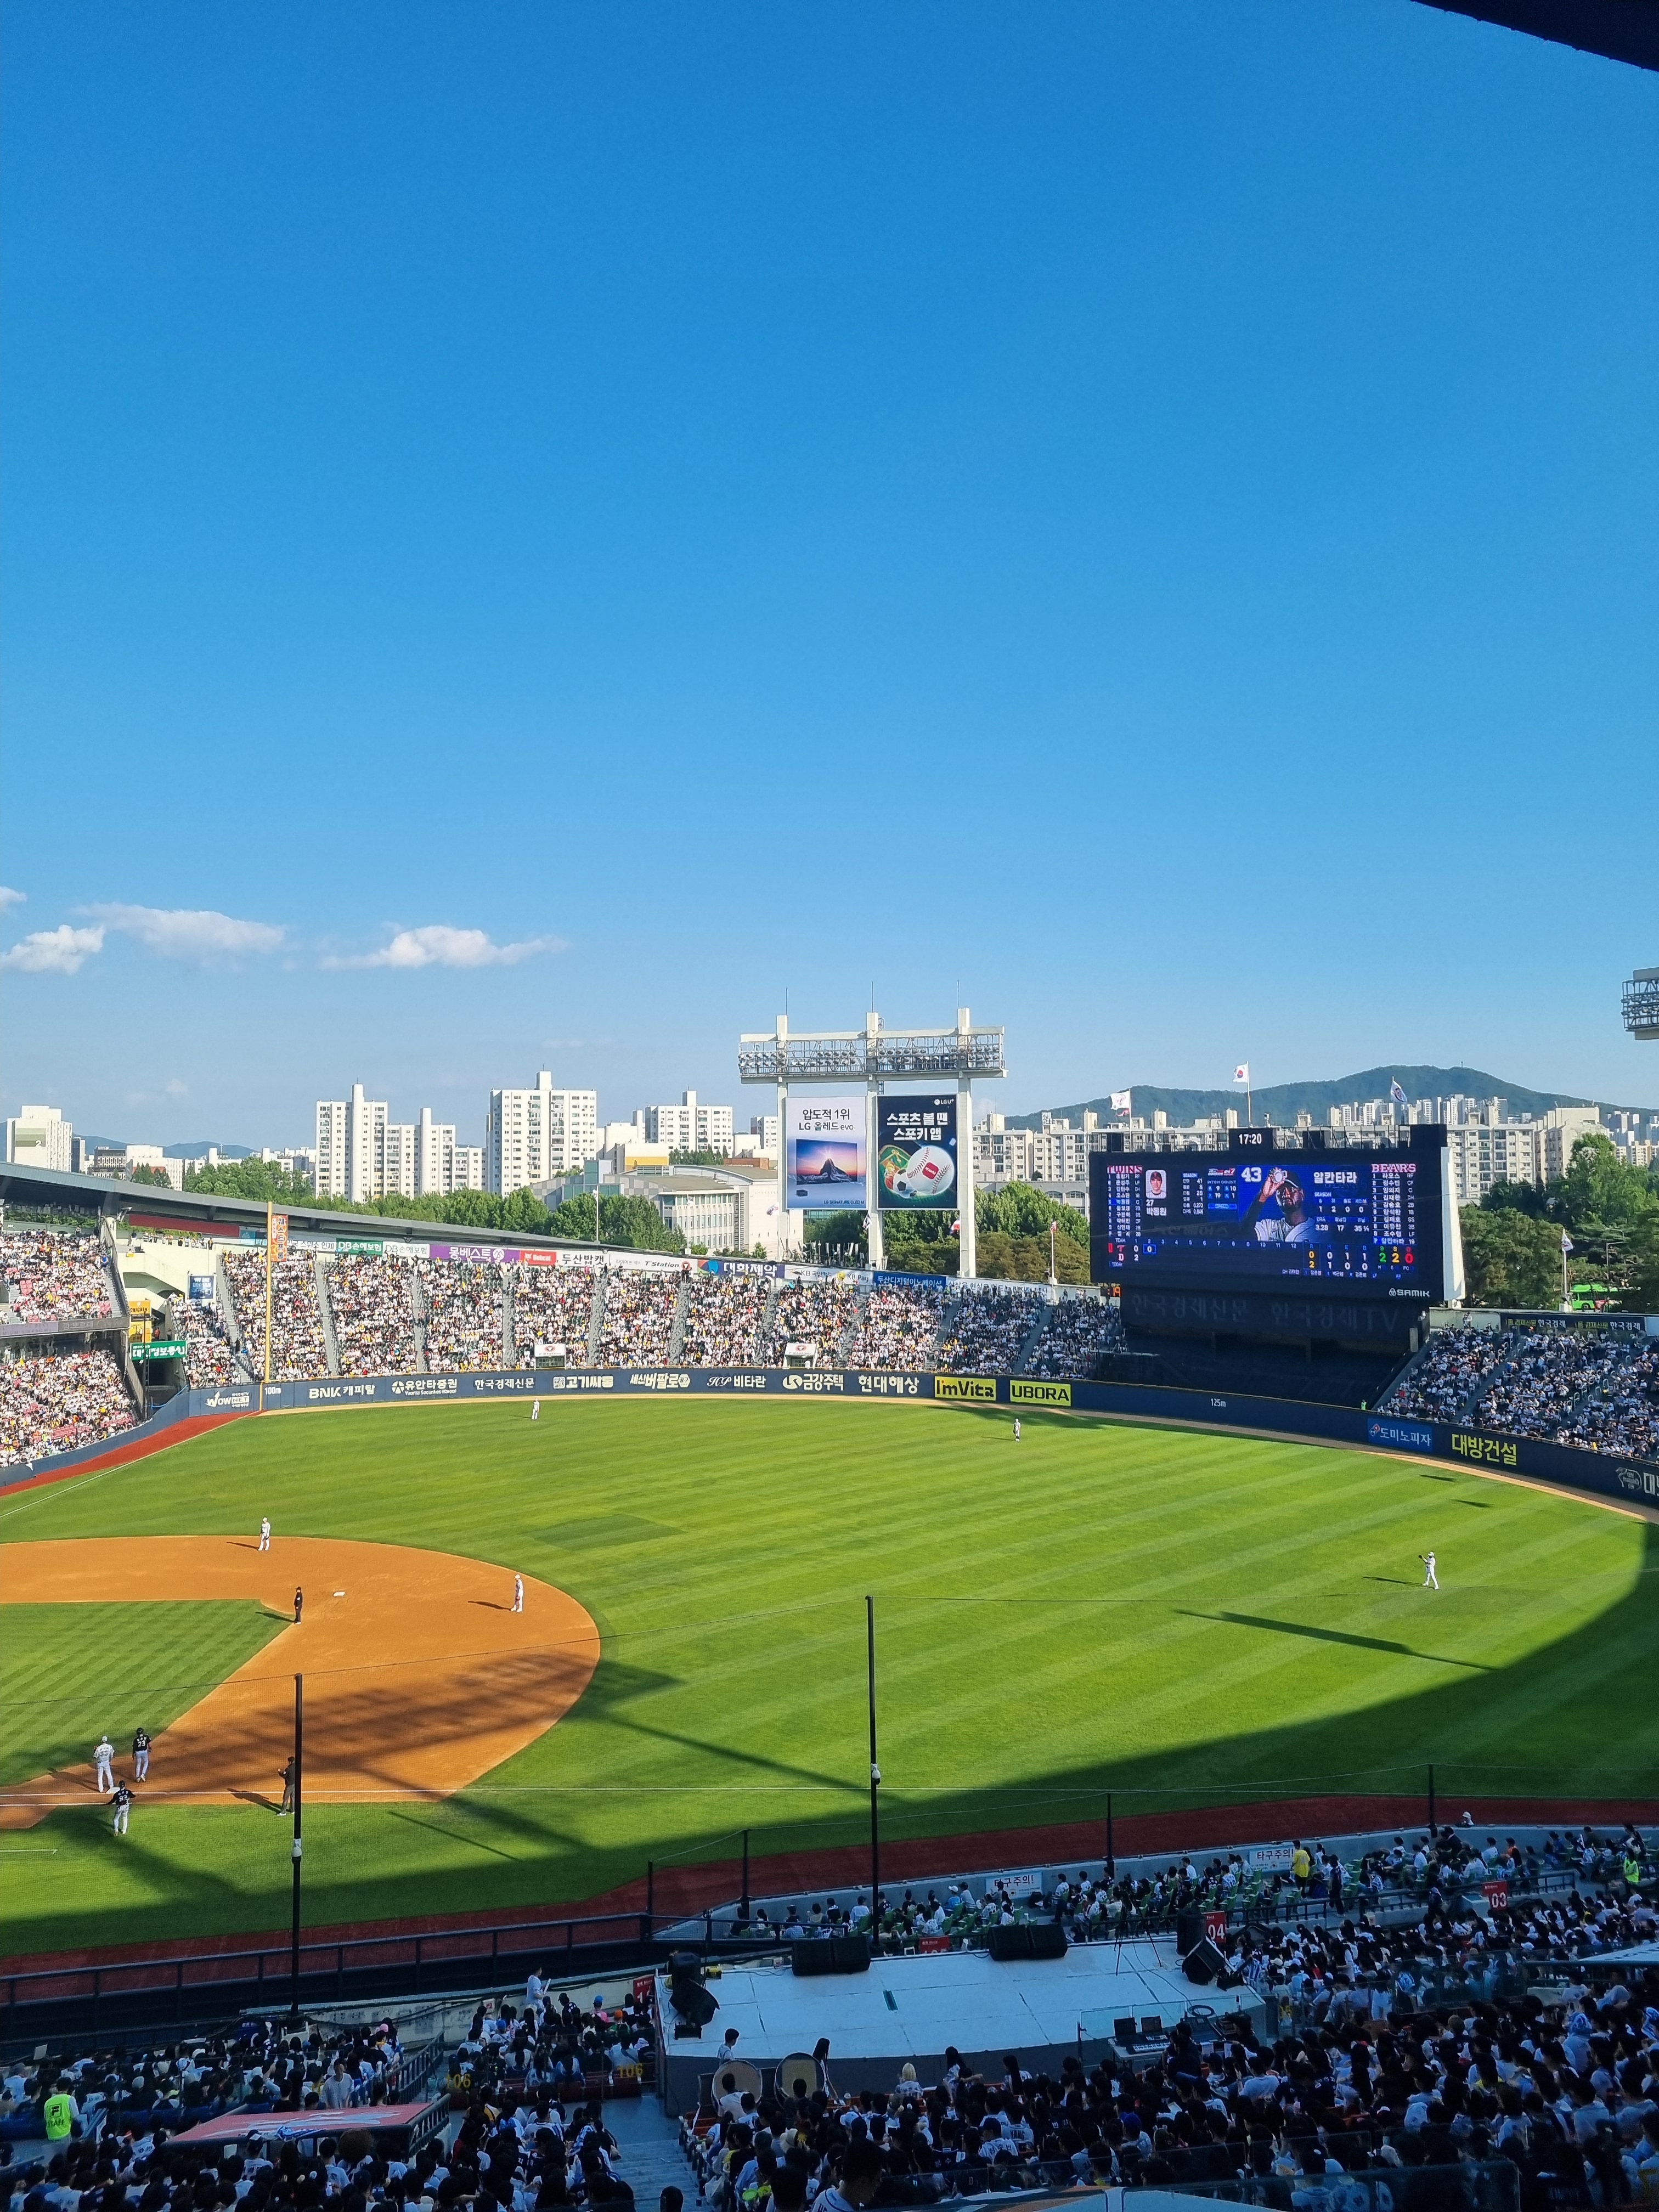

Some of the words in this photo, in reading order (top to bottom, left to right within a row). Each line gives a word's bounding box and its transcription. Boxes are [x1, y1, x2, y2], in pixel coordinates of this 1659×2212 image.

[803, 1108, 832, 1120] 압도적
[834, 1108, 850, 1120] 1위
[887, 1113, 921, 1126] 스포츠
[923, 1113, 935, 1126] 볼
[937, 1113, 948, 1126] 땐
[799, 1122, 811, 1131] LG
[814, 1121, 839, 1131] 올레드
[894, 1127, 928, 1141] 스포키
[930, 1127, 941, 1141] 앱
[1239, 1133, 1262, 1144] 17:20
[1372, 1164, 1416, 1172] BEARS
[1241, 1167, 1261, 1182] 43
[1313, 1172, 1357, 1183] 알칸타라
[1147, 1207, 1166, 1216] 박동원
[338, 1242, 352, 1250] DB
[352, 1243, 381, 1252] 손해보험
[385, 1244, 398, 1254] DB
[399, 1245, 427, 1254] 손해보험
[449, 1247, 492, 1260] 몽베스트
[1379, 1253, 1386, 1262] 2
[1392, 1253, 1400, 1263] 2
[1405, 1253, 1413, 1263] 0
[561, 1254, 605, 1266] 두산밥캣
[1345, 1262, 1350, 1270] 0
[724, 1262, 777, 1277] 대화제약
[857, 1274, 869, 1283] Pay
[877, 1276, 942, 1288] 두산디지털이노베이션
[1397, 1288, 1430, 1297] SAMIK
[1538, 1319, 1566, 1328] 한국경제
[1610, 1321, 1641, 1330] 한국경제
[405, 1379, 458, 1390] 유안타증권
[475, 1378, 535, 1391] 한국경제신문
[630, 1373, 679, 1389] 세신버팔로
[733, 1375, 766, 1388] 비타란
[803, 1374, 844, 1391] 금강주택
[858, 1375, 919, 1395] 현대해상
[264, 1386, 281, 1396] 100m
[309, 1387, 341, 1400] BNK
[343, 1384, 376, 1396] 캐피탈
[1012, 1385, 1069, 1401] UBORA
[1210, 1398, 1226, 1408] 125m
[1380, 1426, 1431, 1447] 도미노피자
[1452, 1434, 1517, 1466] 대방건설
[1643, 1472, 1659, 1497] 대
[1257, 1848, 1294, 1860] 타구주의!
[618, 2064, 644, 2078] 106
[445, 2074, 471, 2089] 106
[48, 2119, 64, 2128] STAFF
